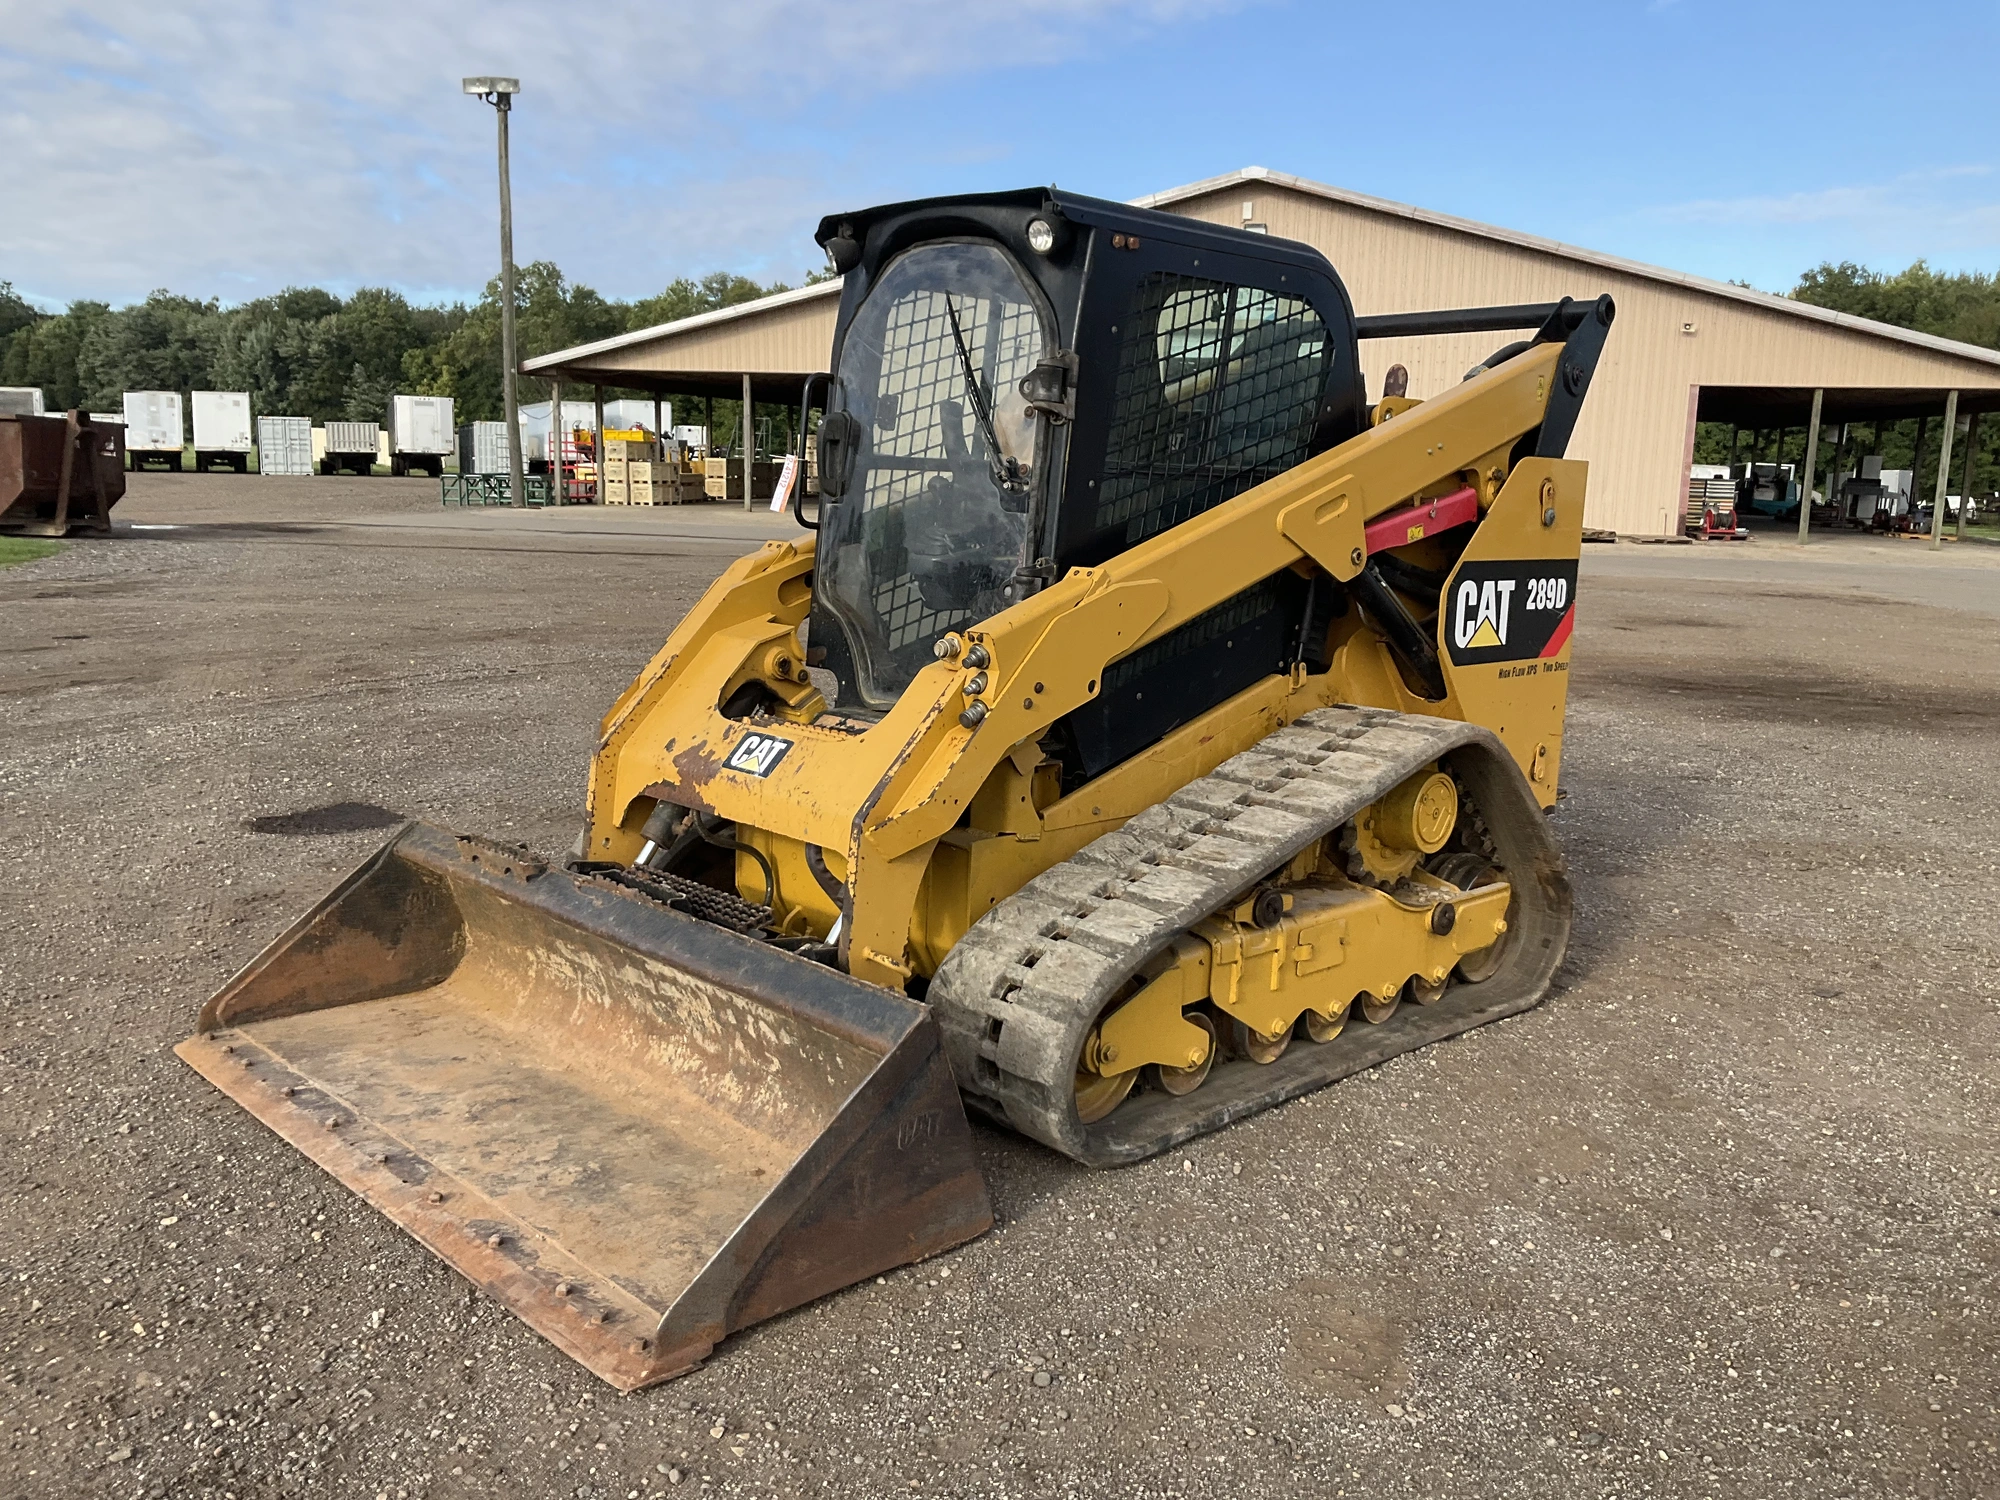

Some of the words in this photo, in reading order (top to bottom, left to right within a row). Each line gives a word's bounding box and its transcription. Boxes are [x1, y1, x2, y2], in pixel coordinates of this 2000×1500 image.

[1455, 580, 1516, 649] CAT
[1526, 578, 1567, 610] 289D
[1526, 664, 1538, 676] XPS
[730, 735, 788, 774] CAT
